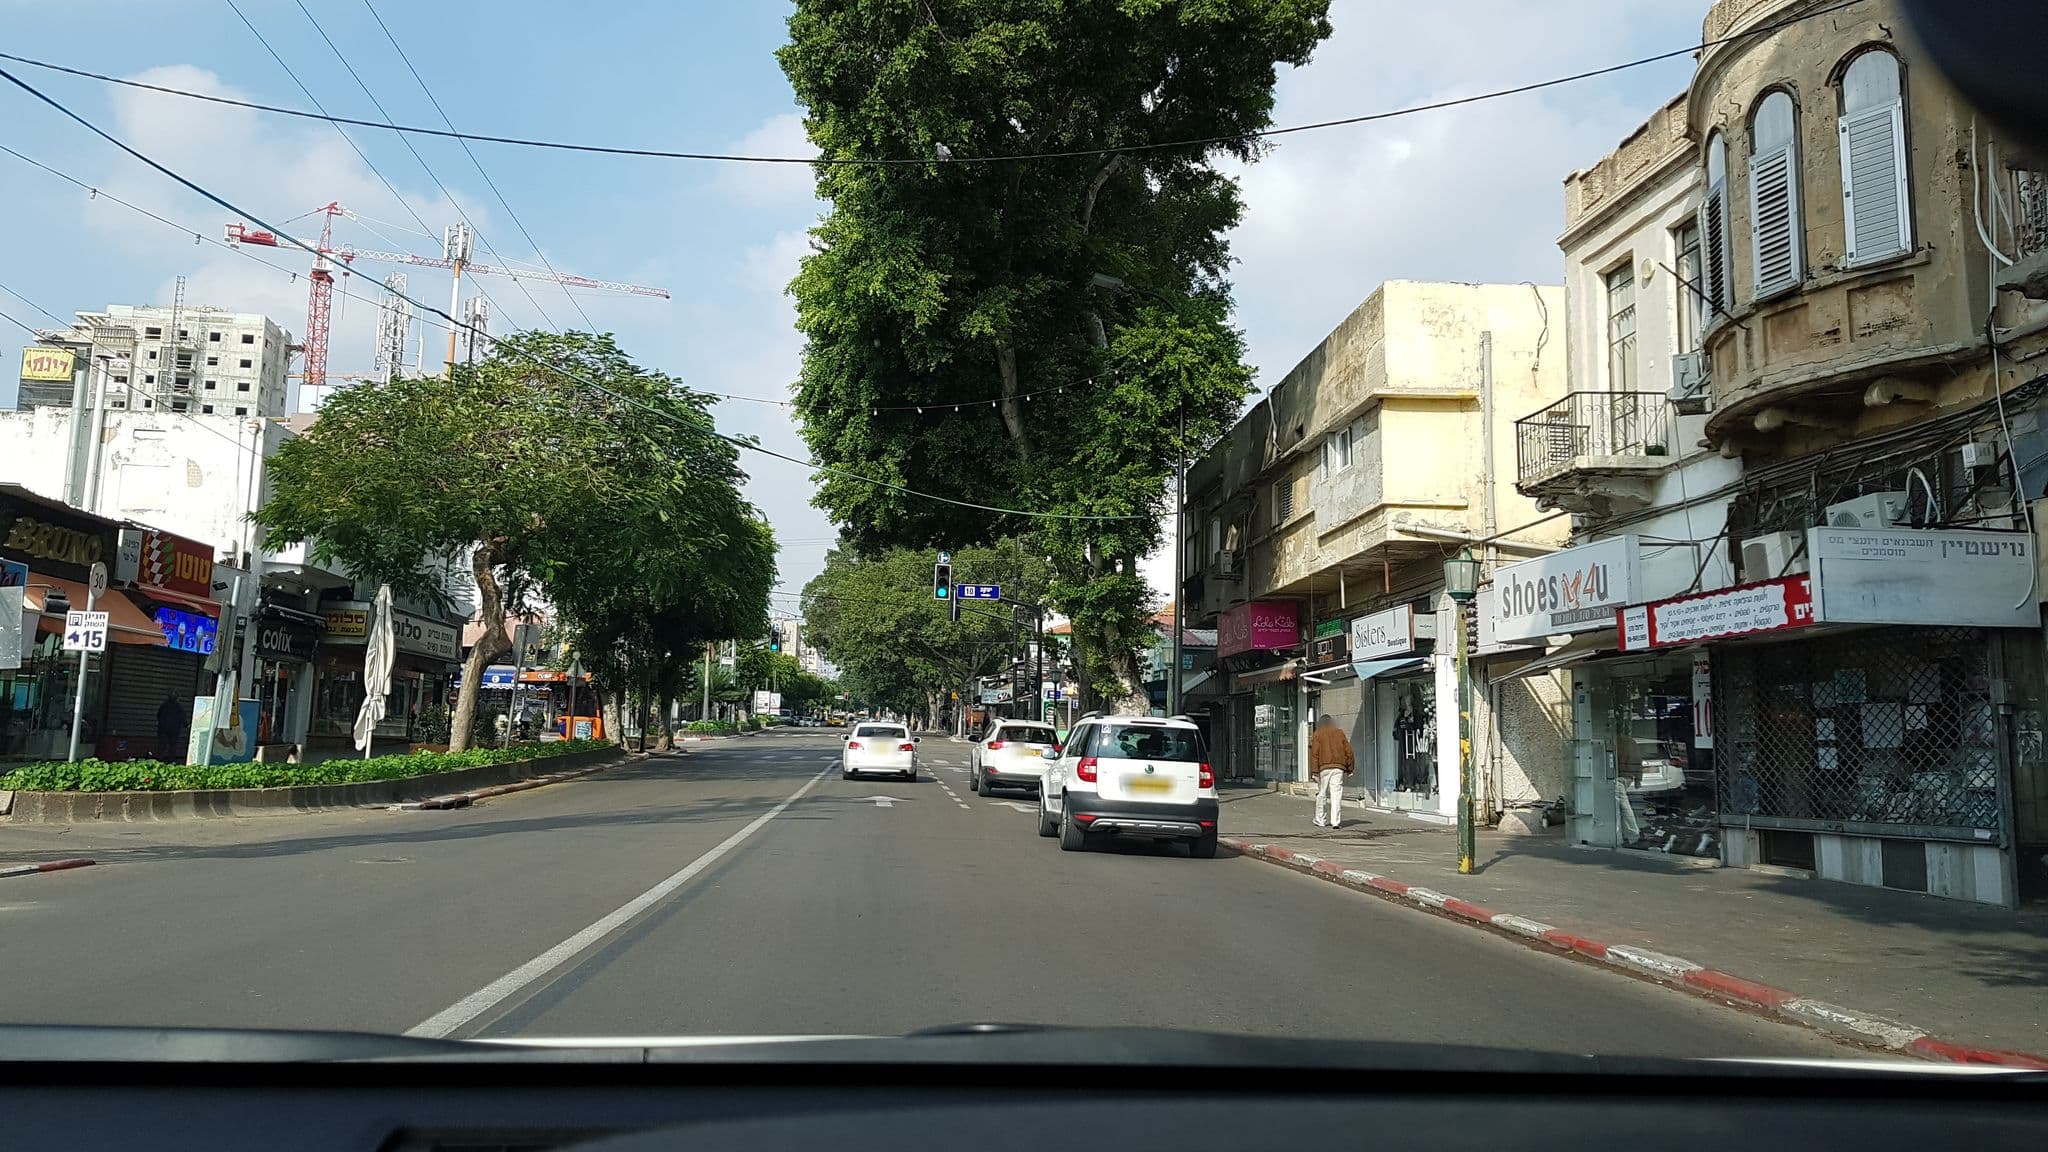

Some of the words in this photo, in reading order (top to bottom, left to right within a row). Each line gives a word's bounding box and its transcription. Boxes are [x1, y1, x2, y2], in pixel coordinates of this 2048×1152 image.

[4, 517, 103, 567] BRUNO
[1940, 538, 2026, 558] נוישטיין
[175, 551, 211, 584] טוטו
[93, 572, 104, 590] 30
[1503, 573, 1558, 618] shoes
[83, 621, 105, 629] השוק
[1354, 623, 1386, 649] Sisters
[82, 630, 103, 648] 15
[262, 626, 293, 653] cofix
[1387, 637, 1408, 647] Boutique
